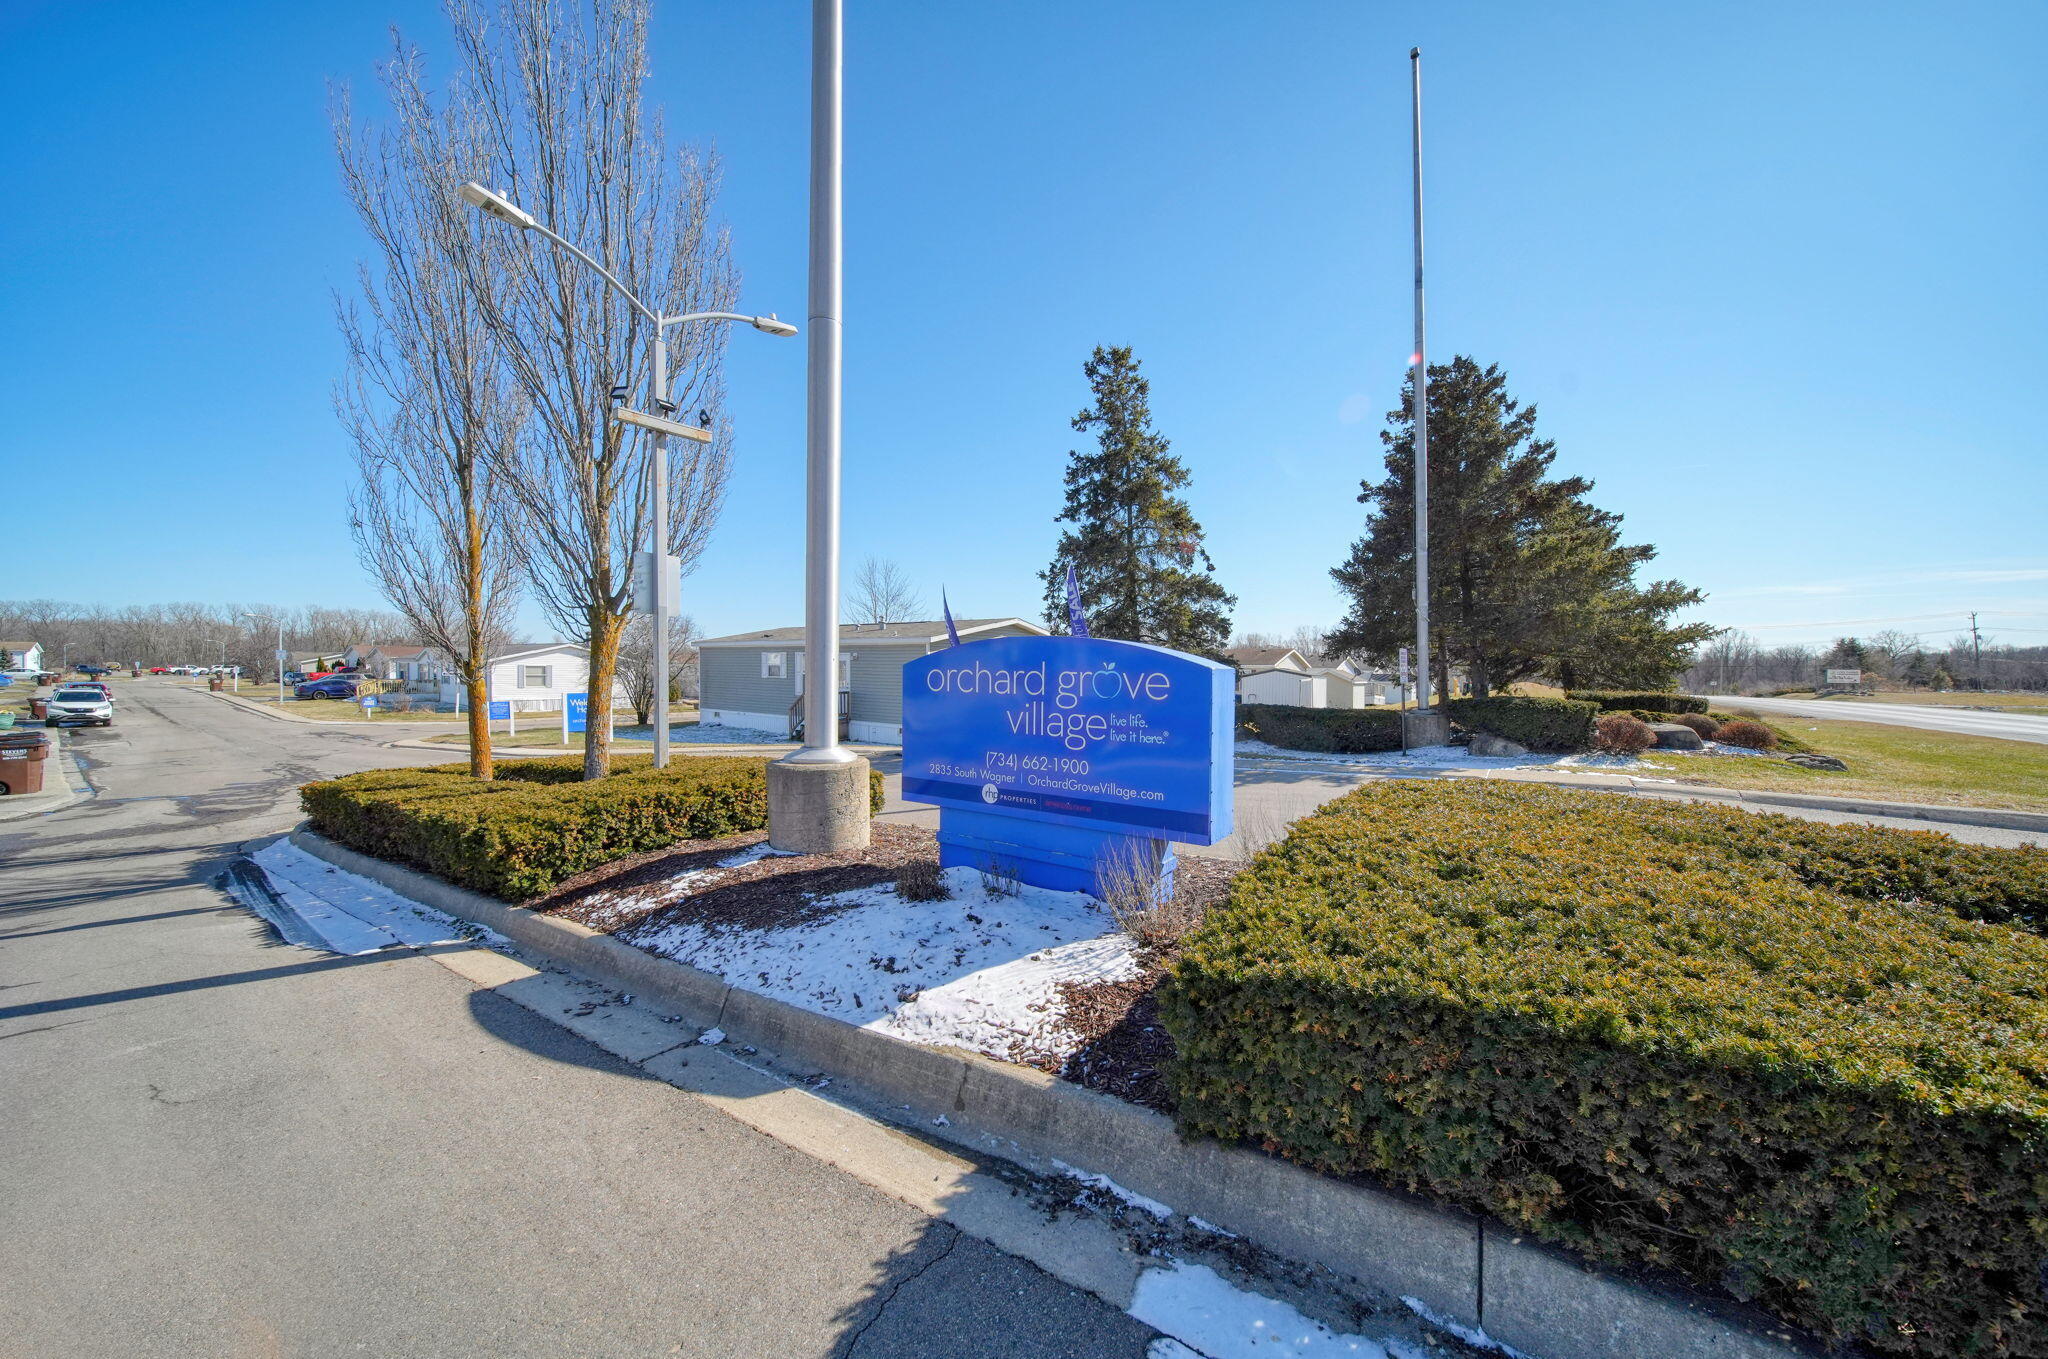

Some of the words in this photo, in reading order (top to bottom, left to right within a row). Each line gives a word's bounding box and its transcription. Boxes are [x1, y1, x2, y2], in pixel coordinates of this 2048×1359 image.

[1067, 581, 1083, 621] SALE
[927, 661, 1045, 695] orchard
[1056, 662, 1170, 709] grove
[1007, 701, 1107, 750] village
[1110, 713, 1127, 727] live
[1129, 713, 1148, 728] life.
[1110, 728, 1127, 742] live
[1129, 731, 1137, 743] it
[986, 751, 1017, 770] (734)
[1022, 756, 1089, 775] 662-1900
[929, 763, 952, 775] 2835
[954, 766, 977, 779] South
[980, 769, 1015, 784] Wagner
[1027, 774, 1164, 801] OrchardGroveVillage.com
[1000, 794, 1037, 804] PROPERTIES
